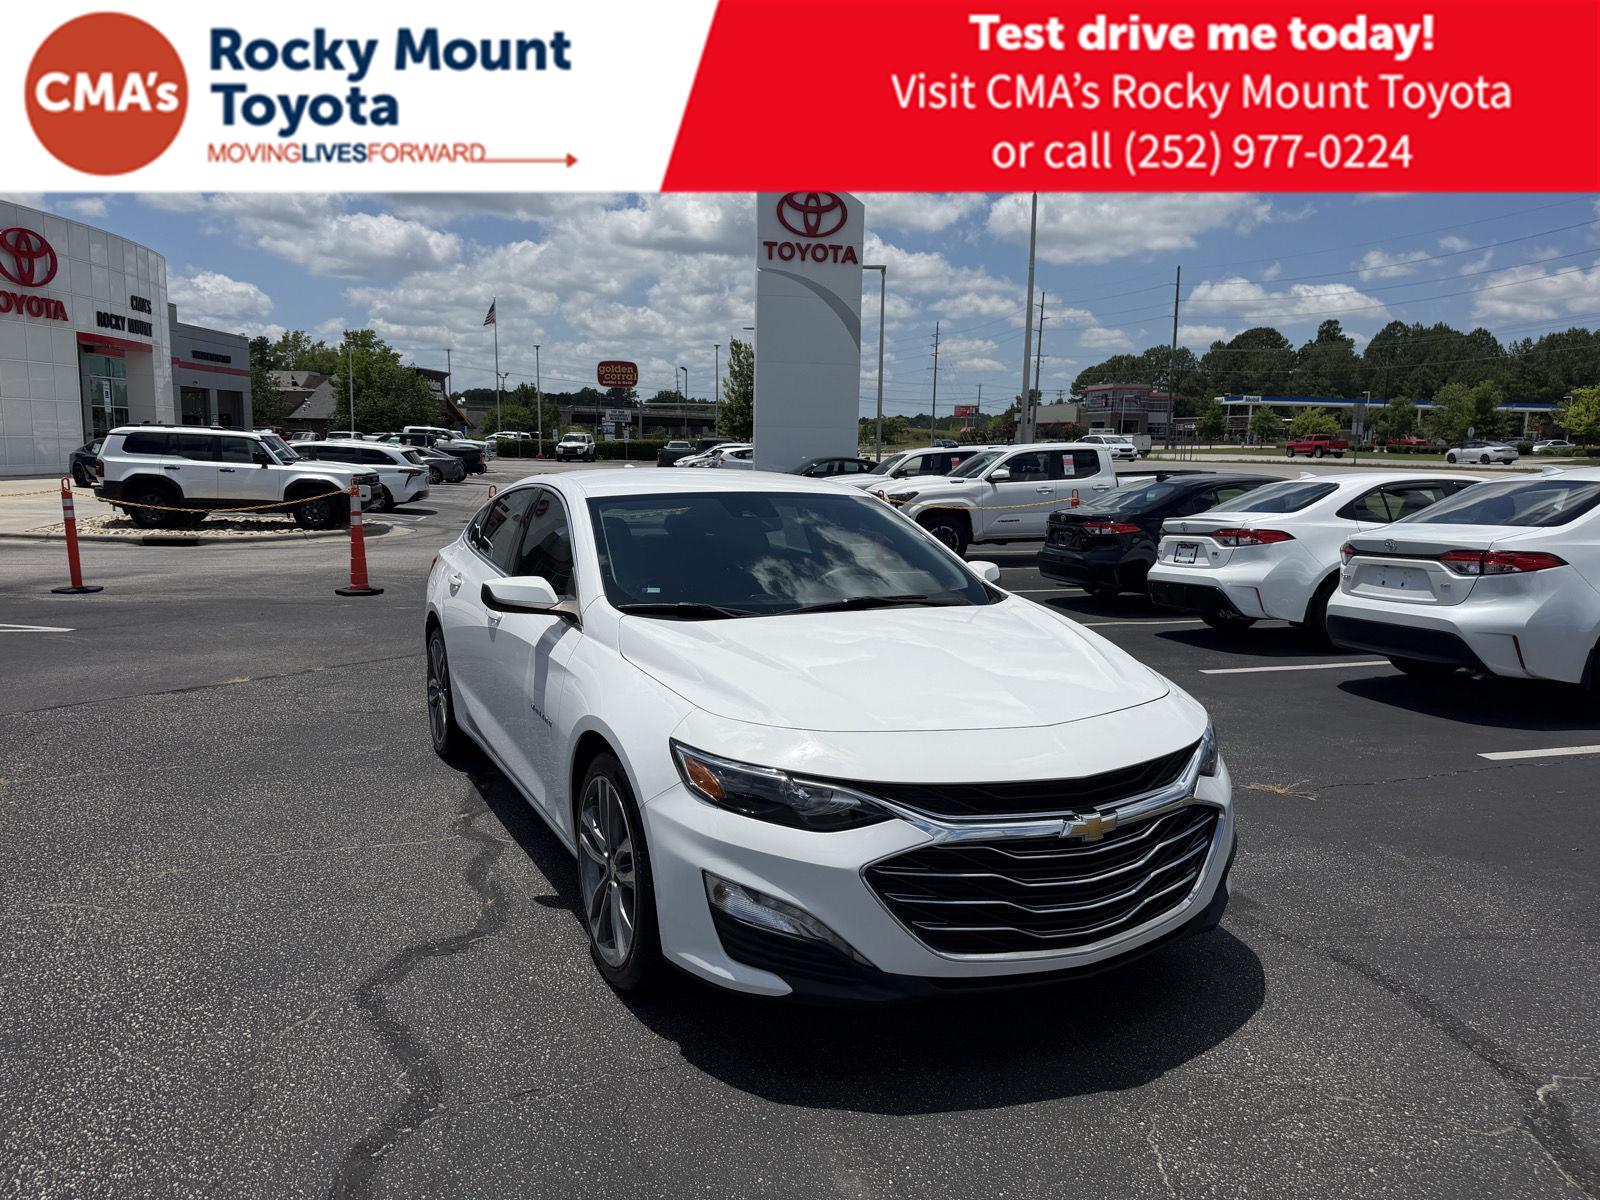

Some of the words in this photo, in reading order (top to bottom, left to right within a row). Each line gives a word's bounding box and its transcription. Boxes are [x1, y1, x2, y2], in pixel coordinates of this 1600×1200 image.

[763, 241, 859, 265] TOYOTA
[96, 310, 126, 331] ROCKY
[127, 317, 153, 337] MOUNT
[599, 365, 634, 375] golden
[604, 373, 637, 381] corral
